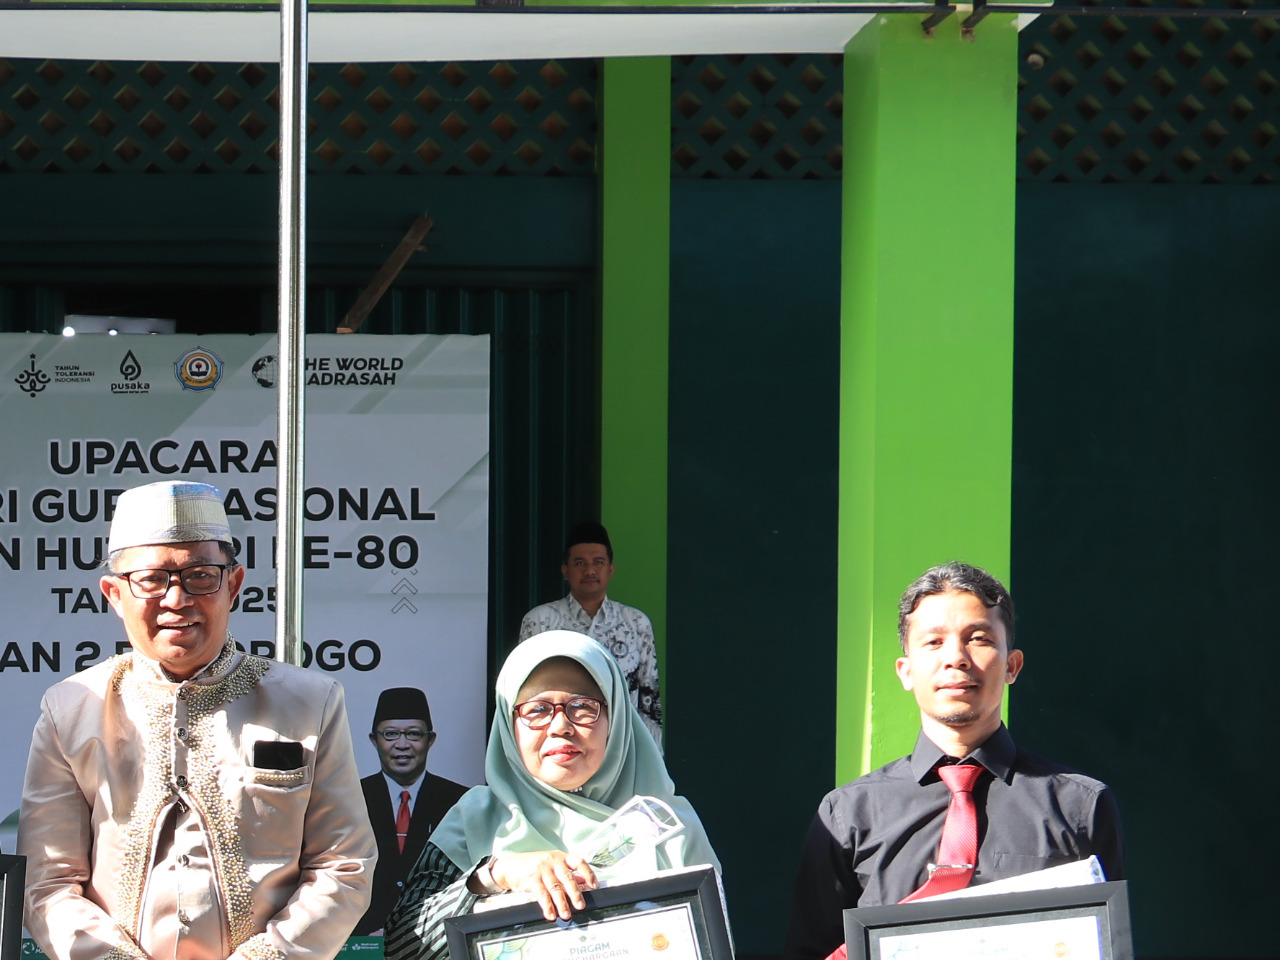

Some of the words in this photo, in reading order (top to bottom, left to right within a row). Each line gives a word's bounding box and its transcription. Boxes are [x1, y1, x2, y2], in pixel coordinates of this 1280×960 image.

[305, 357, 331, 370] HE
[336, 357, 404, 370] WORLD
[111, 381, 150, 391] pusaka
[306, 372, 396, 385] ADRASAH
[50, 440, 278, 474] UPACARA
[32, 489, 121, 522] GU
[224, 487, 436, 522] ASONAL
[37, 537, 109, 571] HU
[273, 534, 419, 569] E-80
[74, 641, 101, 672] 2
[569, 941, 611, 956] PIAGAM
